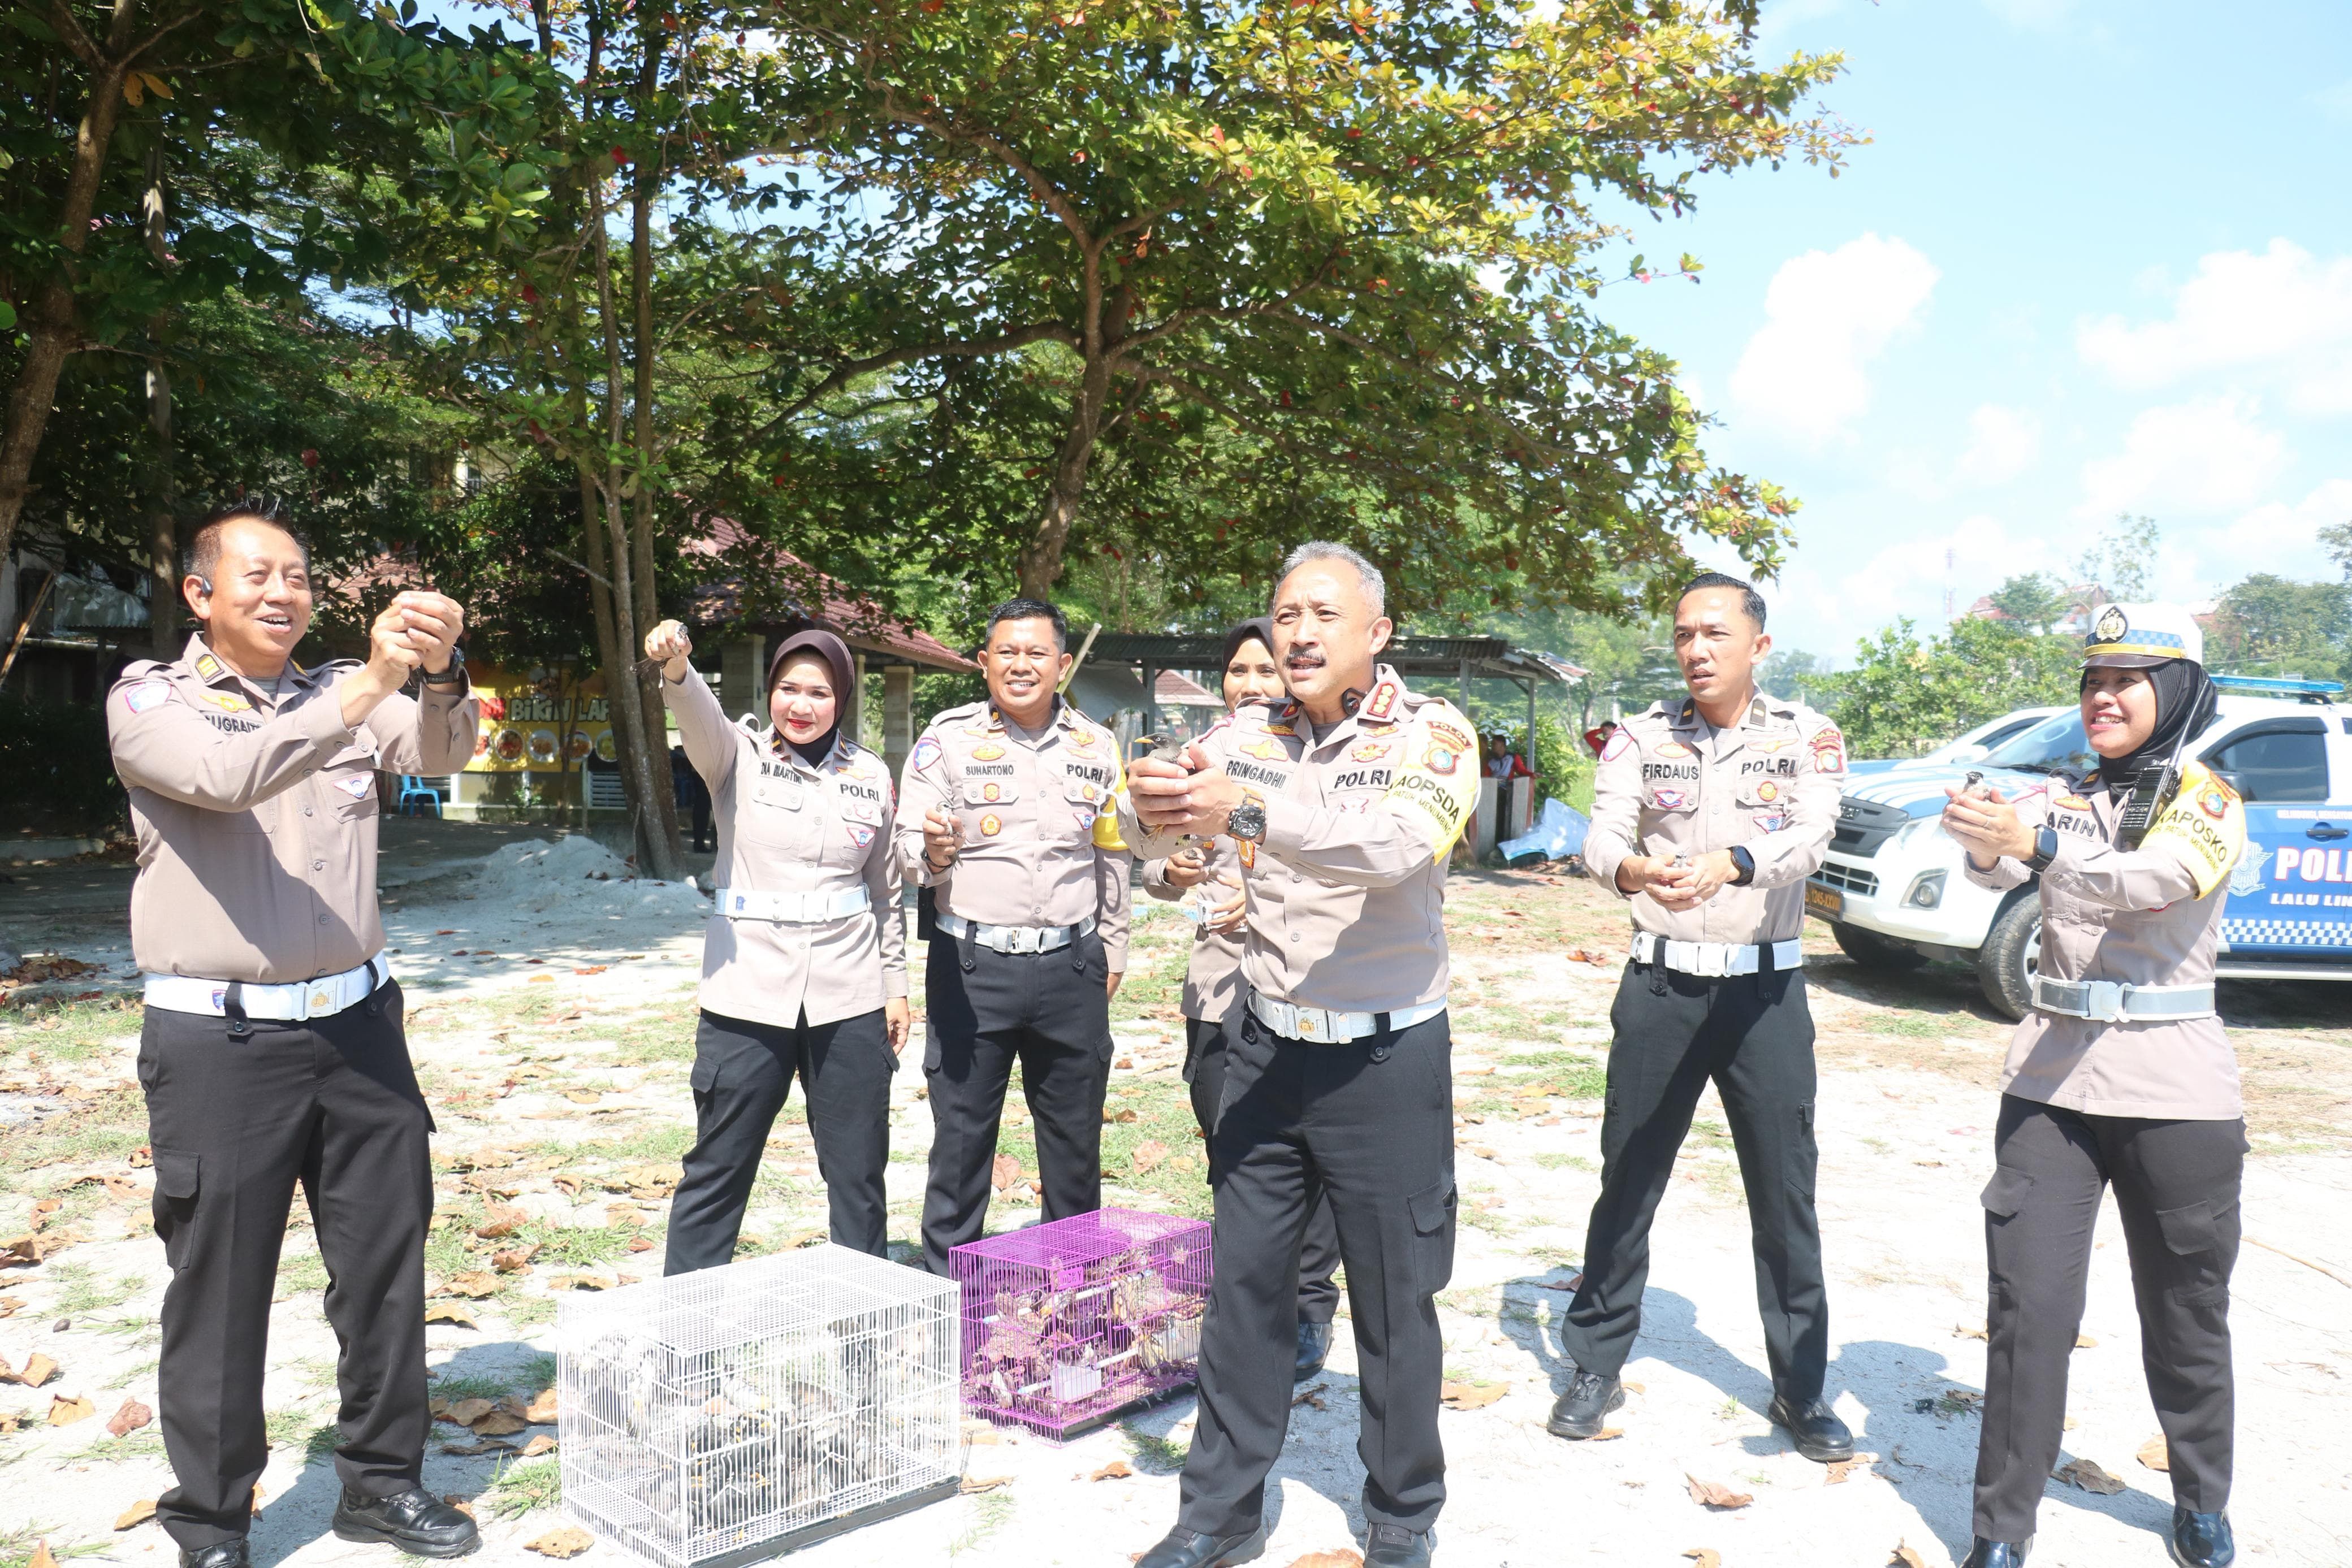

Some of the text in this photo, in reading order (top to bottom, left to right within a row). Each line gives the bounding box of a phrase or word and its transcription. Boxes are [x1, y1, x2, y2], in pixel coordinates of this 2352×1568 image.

[1432, 722, 1468, 746] POLDA
[773, 764, 802, 785] MARTINI
[966, 764, 1014, 776] SUHARTONO
[1066, 764, 1102, 782] POLRI
[1226, 760, 1287, 789] PRINGADHI
[1642, 764, 1699, 779] FIRDAUS
[1741, 759, 1796, 775] POLRI
[1334, 769, 1391, 789] POLRI
[840, 783, 879, 802] POLRI
[1417, 798, 1452, 837] MENUMBING
[2159, 809, 2227, 863] APOSKO
[2270, 893, 2320, 906] LALU
